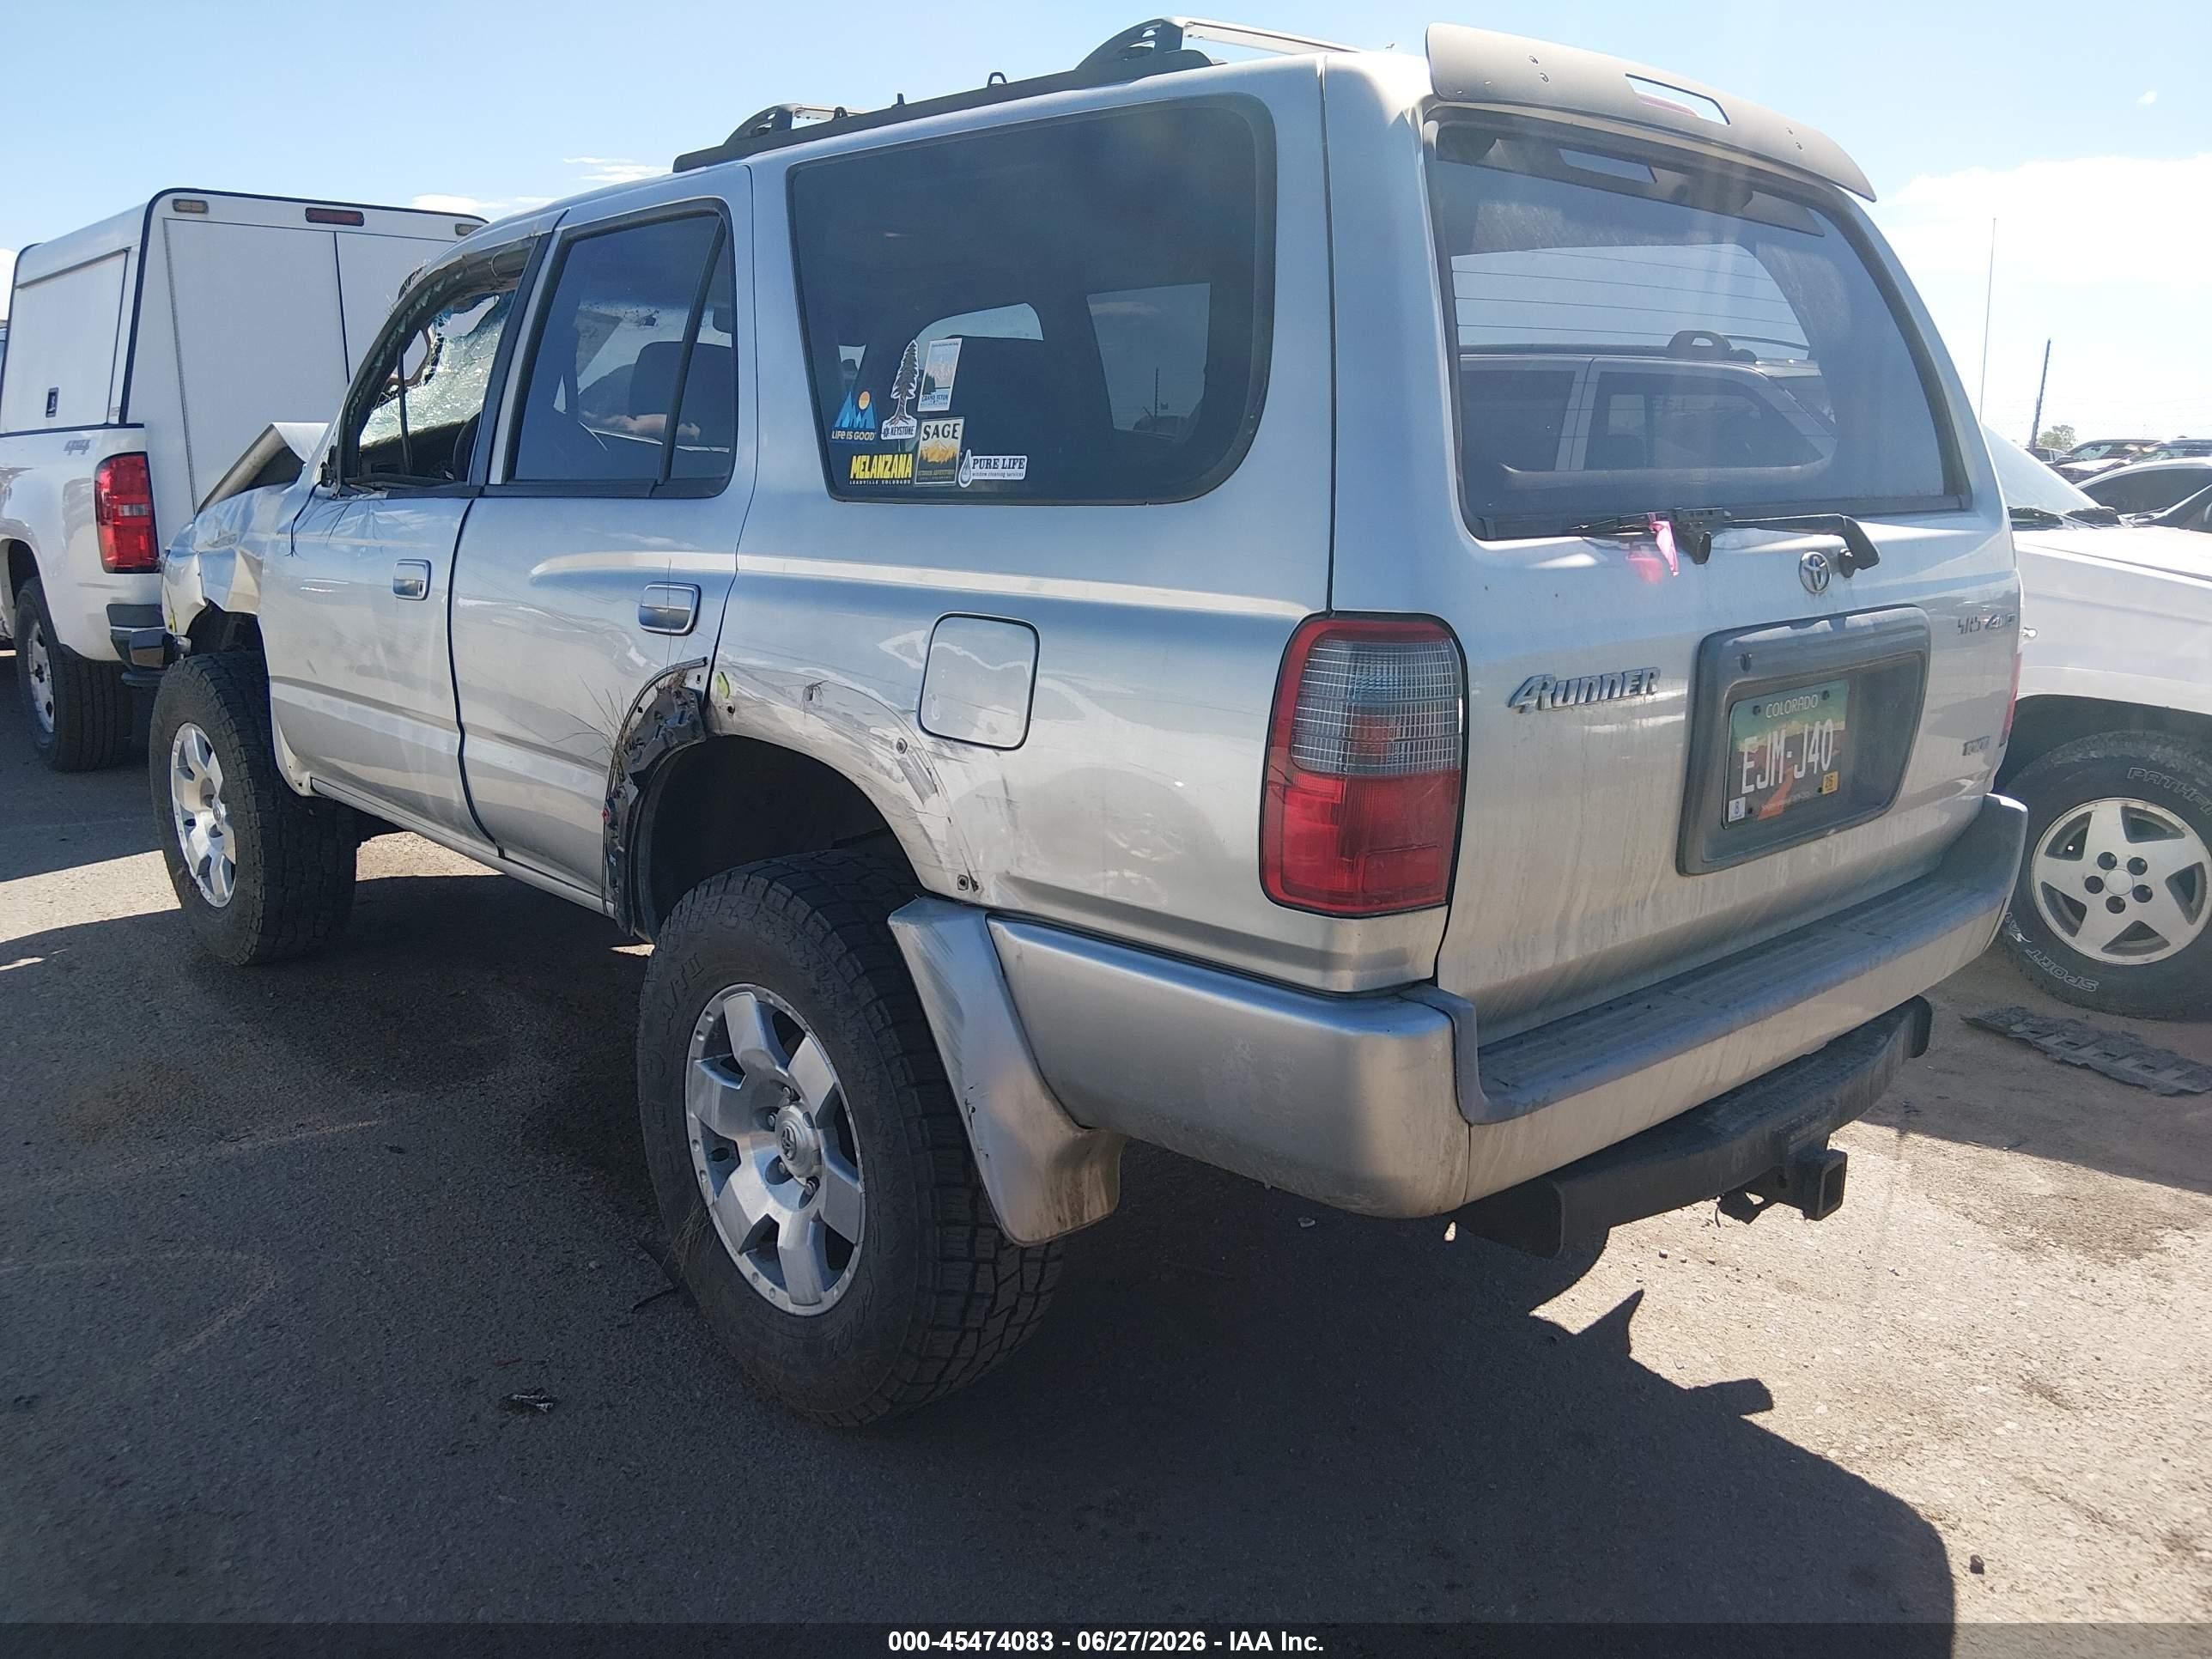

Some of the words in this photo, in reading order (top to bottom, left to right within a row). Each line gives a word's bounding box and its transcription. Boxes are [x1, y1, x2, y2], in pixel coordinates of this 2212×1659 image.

[854, 431, 874, 441] GOOD
[890, 425, 915, 436] KEYSTONE
[921, 422, 961, 441] SAGE
[849, 453, 913, 479] MELANZANA
[972, 458, 1000, 470] PURE
[1000, 458, 1026, 470] LIFE
[1765, 694, 1819, 719] COLORADO
[2025, 949, 2100, 993] SPORT
